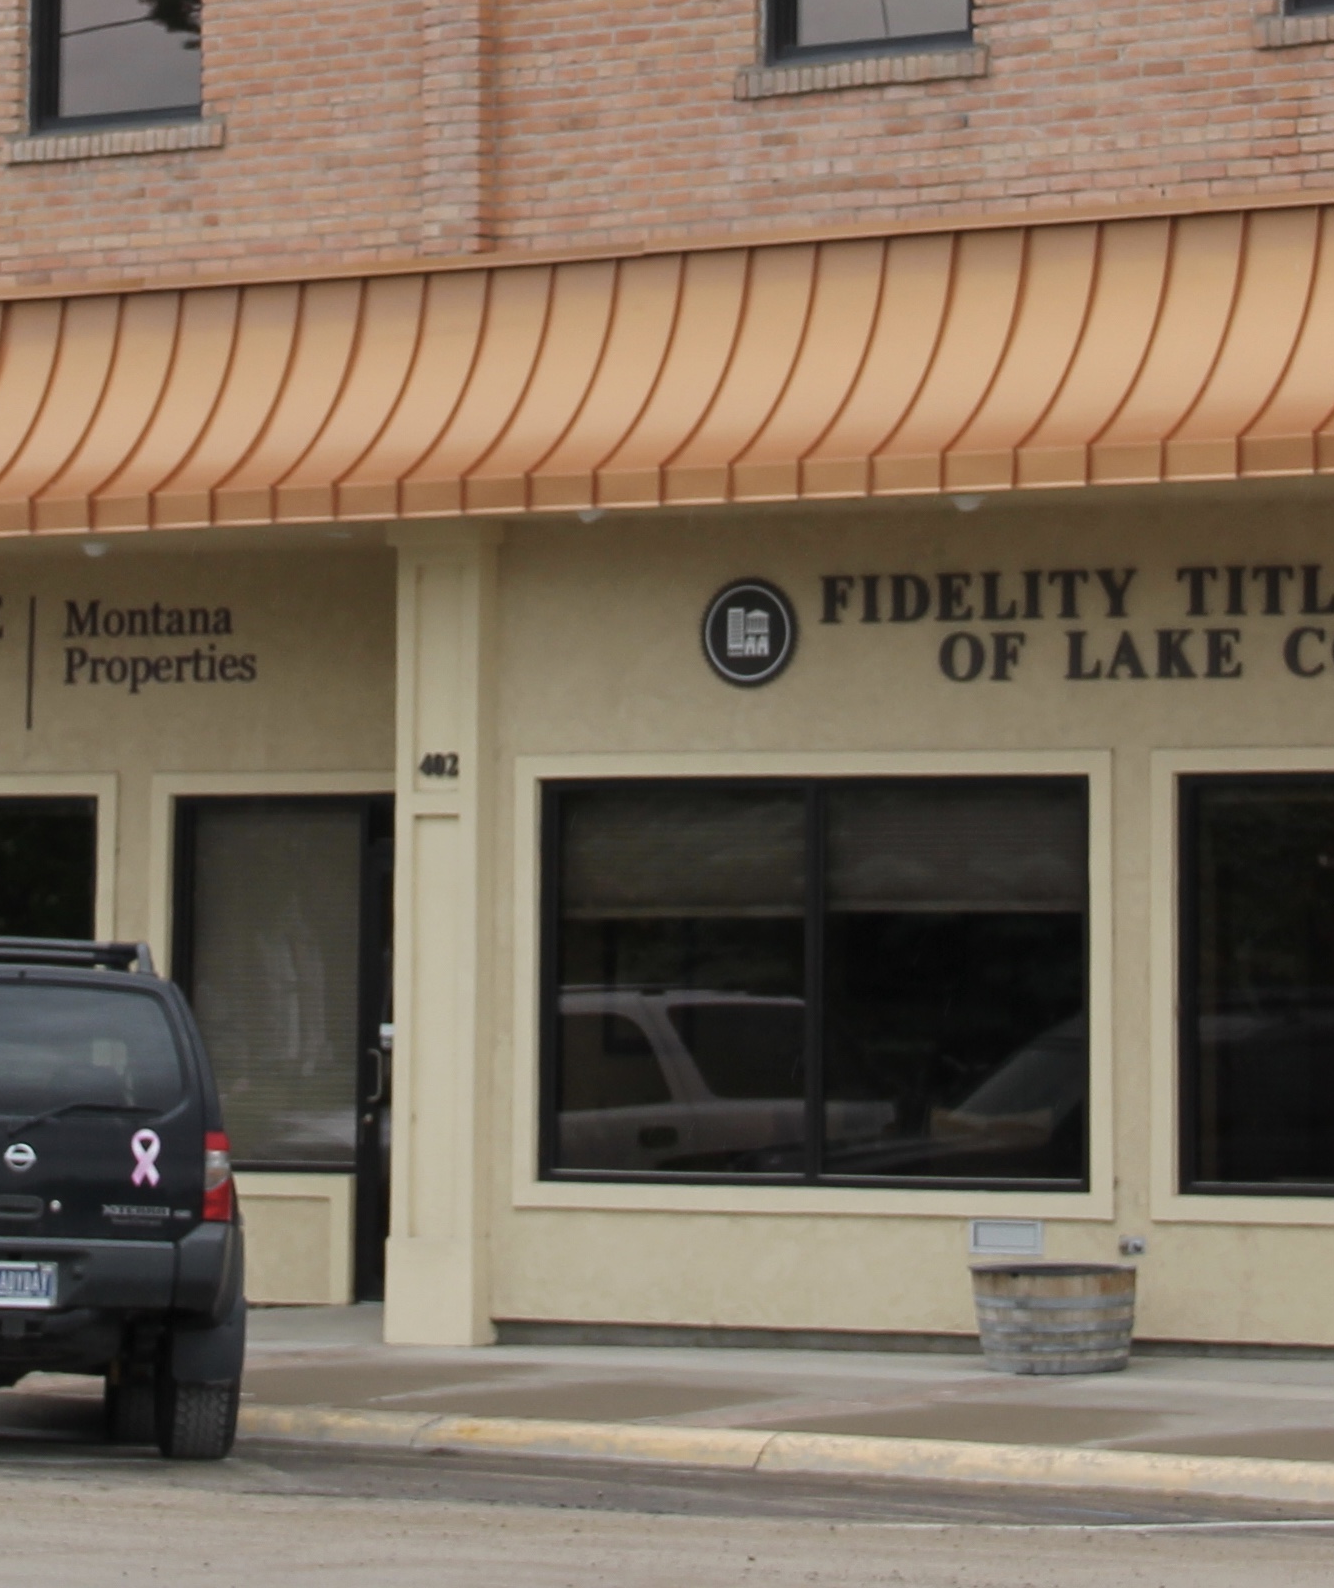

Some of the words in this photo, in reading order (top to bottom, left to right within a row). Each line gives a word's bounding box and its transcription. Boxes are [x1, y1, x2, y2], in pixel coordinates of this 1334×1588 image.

[63, 599, 233, 638] Montana
[819, 568, 1139, 624] FIDELITY
[64, 645, 257, 692] Properties
[938, 630, 1026, 683] OF
[1065, 625, 1243, 680] LAKE
